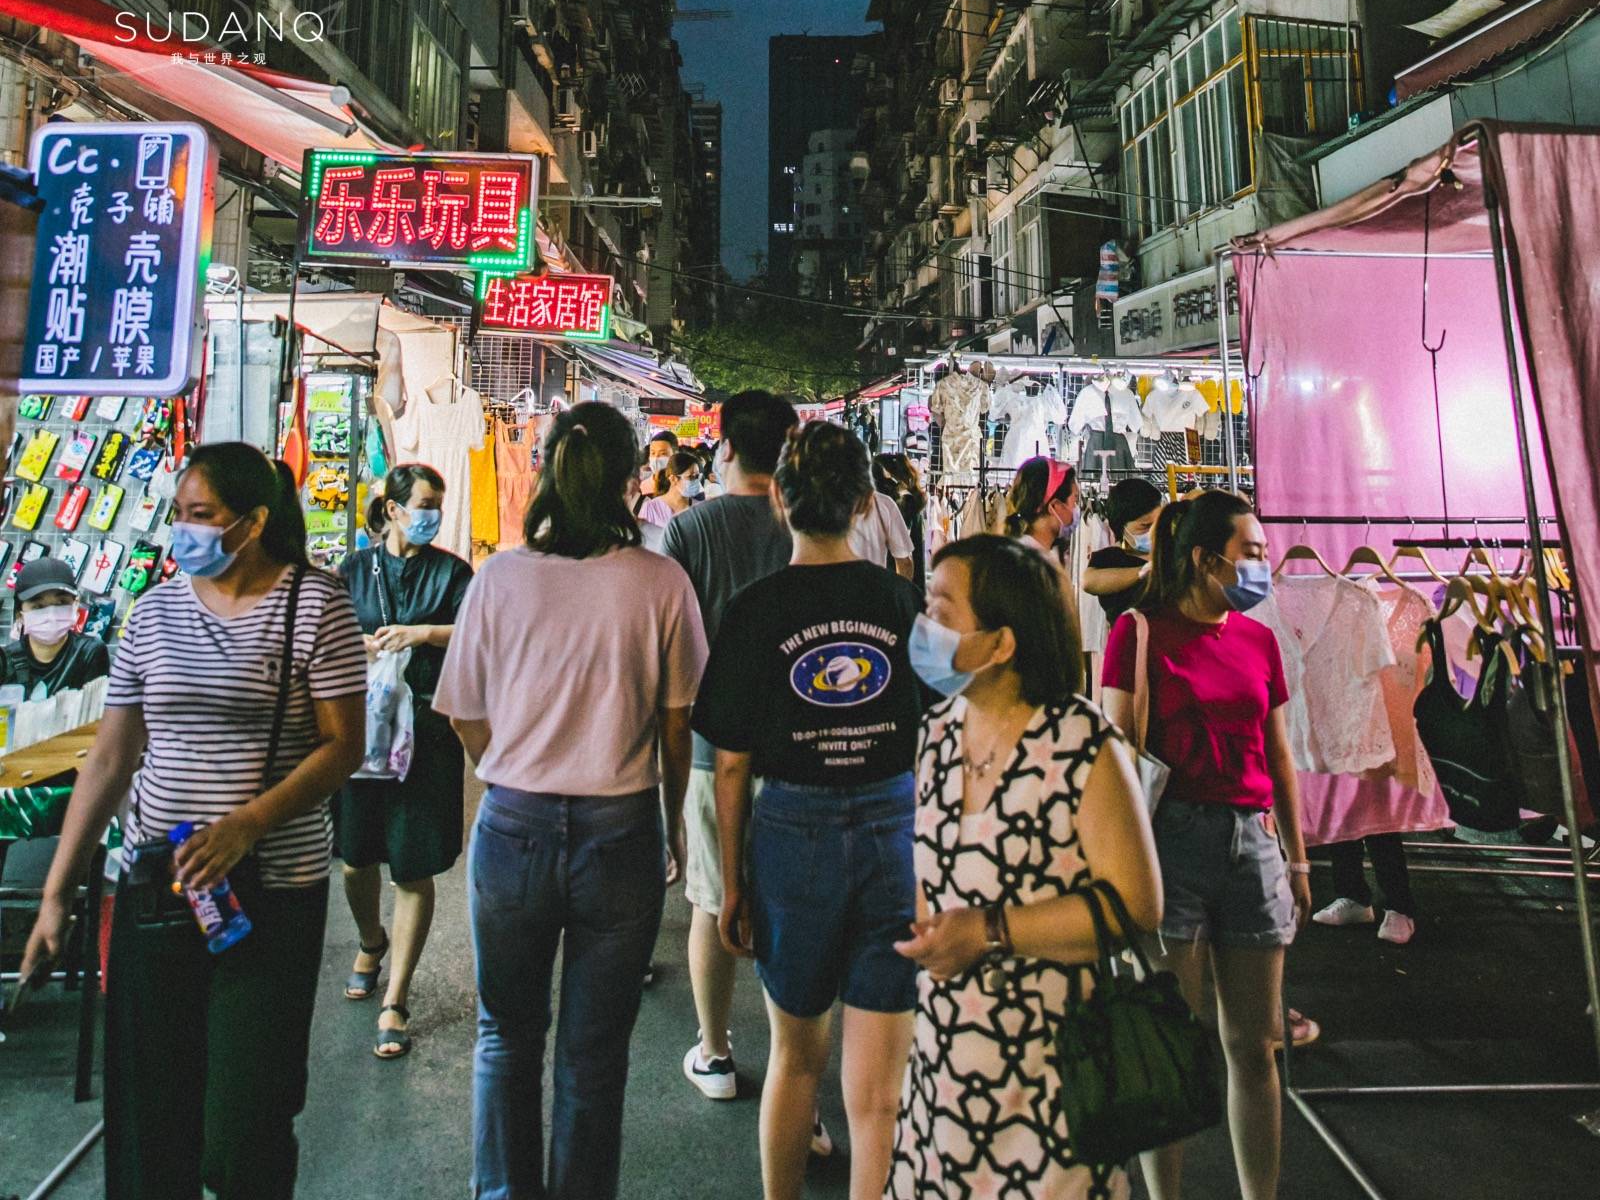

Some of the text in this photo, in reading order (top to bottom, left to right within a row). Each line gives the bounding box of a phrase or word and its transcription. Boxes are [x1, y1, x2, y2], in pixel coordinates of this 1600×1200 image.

[314, 166, 520, 249] 乐乐玩具
[484, 278, 604, 330] 生活家居馆
[95, 553, 111, 580] 中
[780, 620, 898, 655] THE NEW BEGINNING
[818, 739, 872, 752] INVITE ONLY
